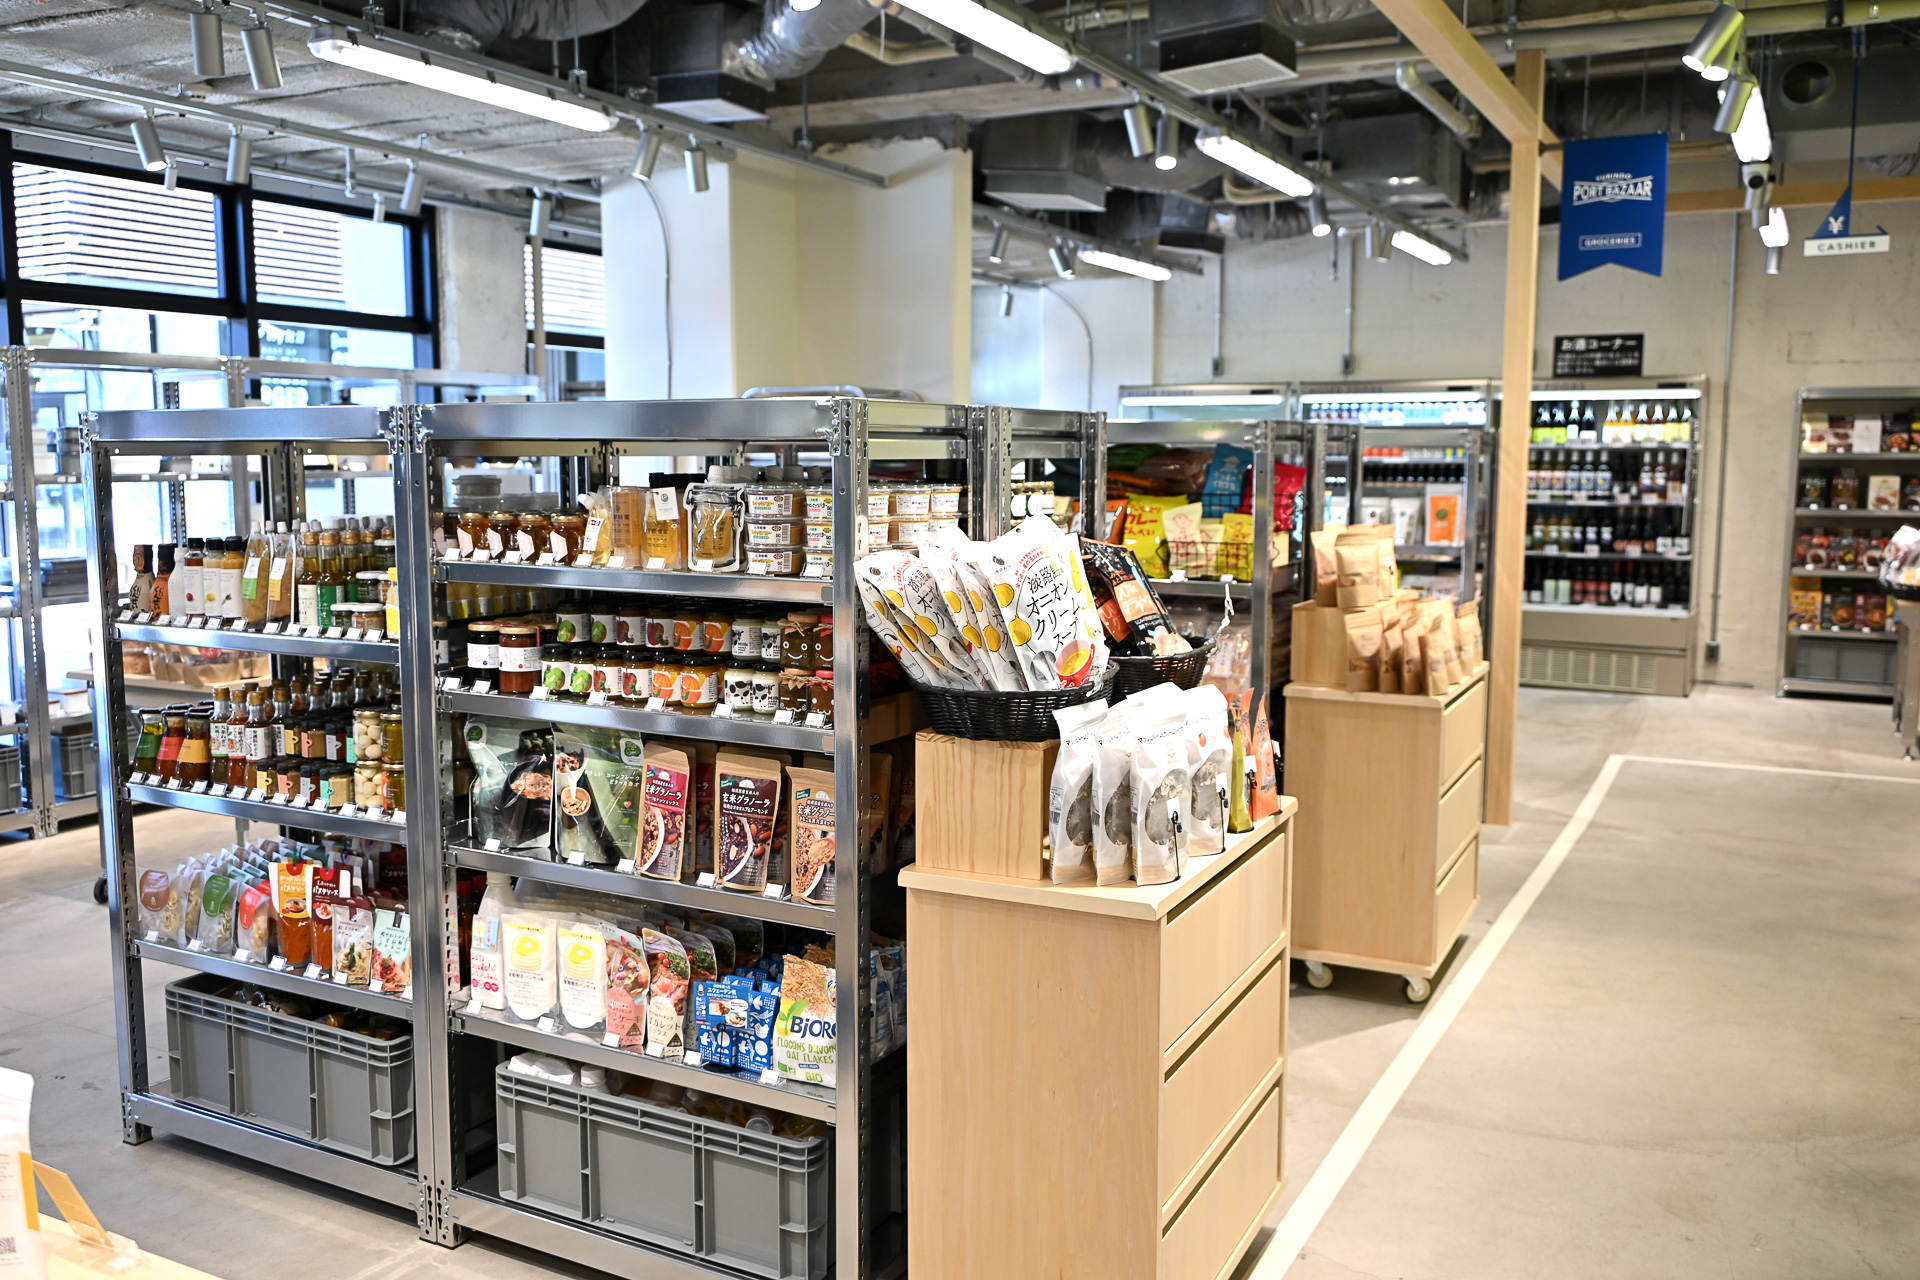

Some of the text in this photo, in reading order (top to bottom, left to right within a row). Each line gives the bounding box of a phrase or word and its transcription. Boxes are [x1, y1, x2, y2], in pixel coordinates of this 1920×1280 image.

[1573, 180, 1652, 201] PORT BAZAAR
[1817, 240, 1876, 252] CASHIER
[1026, 577, 1069, 618] オニオン
[1034, 597, 1080, 641] クリーム
[1052, 616, 1079, 652] スープ
[722, 791, 771, 807] 玄米グラノーラ
[312, 885, 339, 896] パスタソース
[777, 1036, 806, 1052] FLOCONS
[786, 1050, 835, 1065] OAT FLAKES
[805, 1071, 824, 1083] BIO
